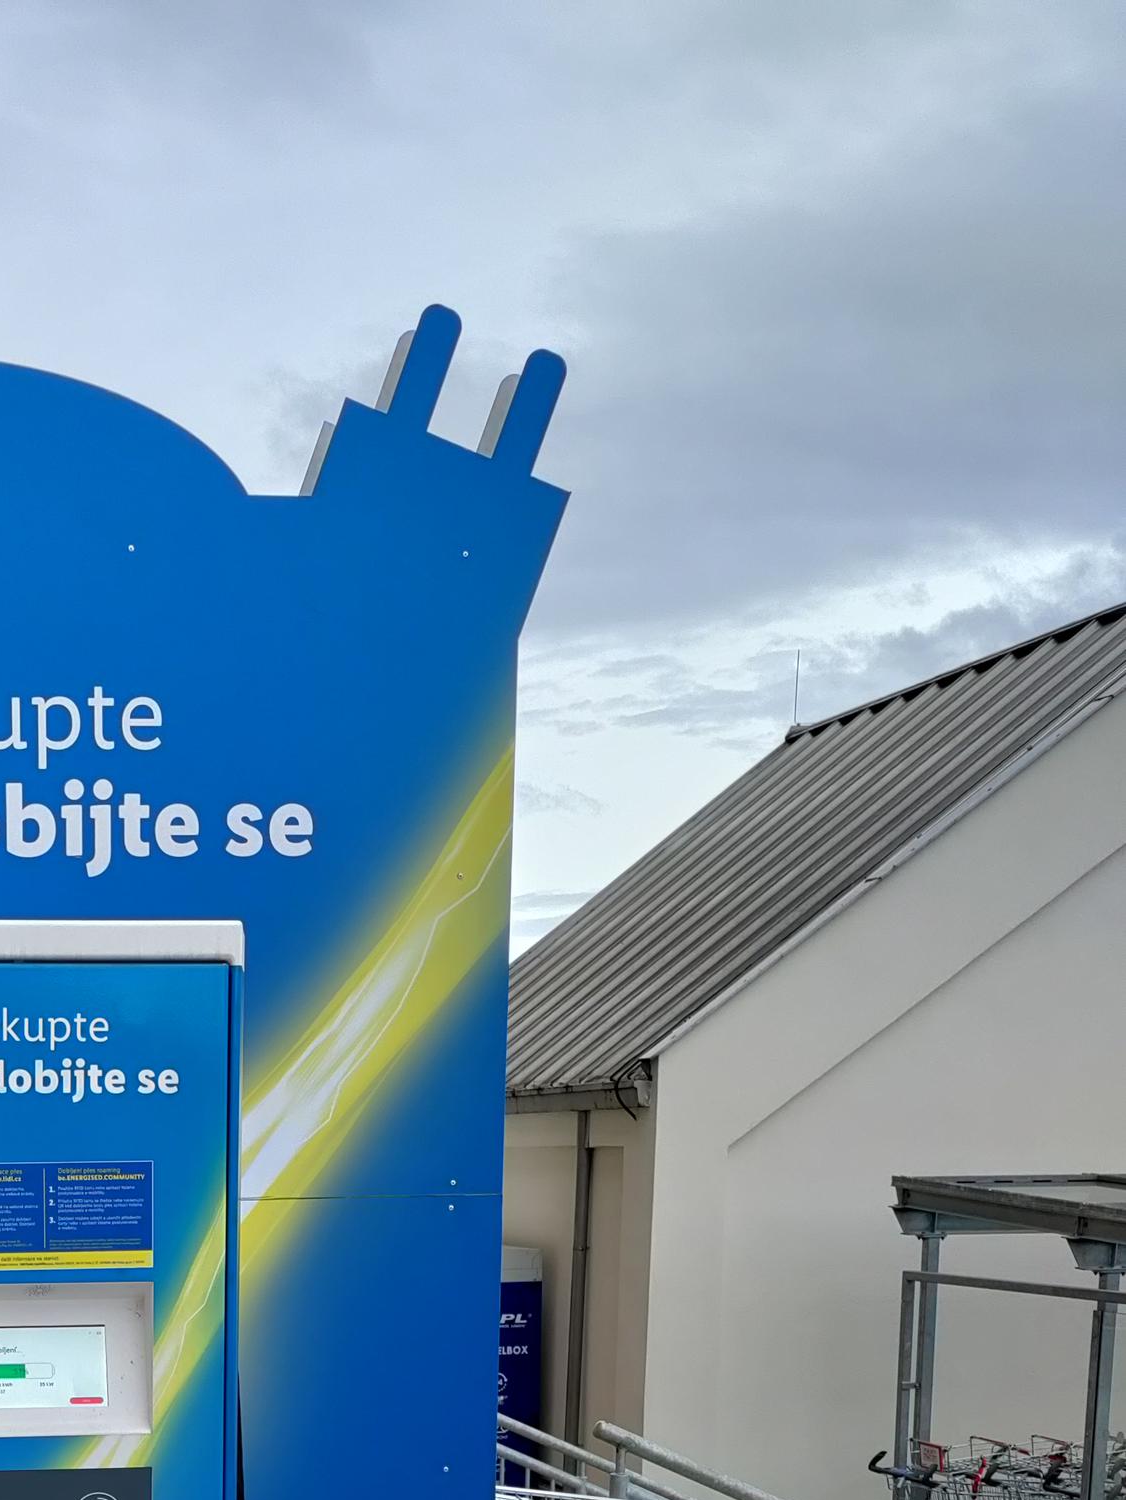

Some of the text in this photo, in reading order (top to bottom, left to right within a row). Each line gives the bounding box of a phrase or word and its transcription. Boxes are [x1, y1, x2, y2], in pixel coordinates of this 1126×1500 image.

[226, 800, 314, 858] se
[137, 1065, 179, 1094] se
[499, 1313, 528, 1324] PL
[498, 1345, 529, 1355] ELBOX
